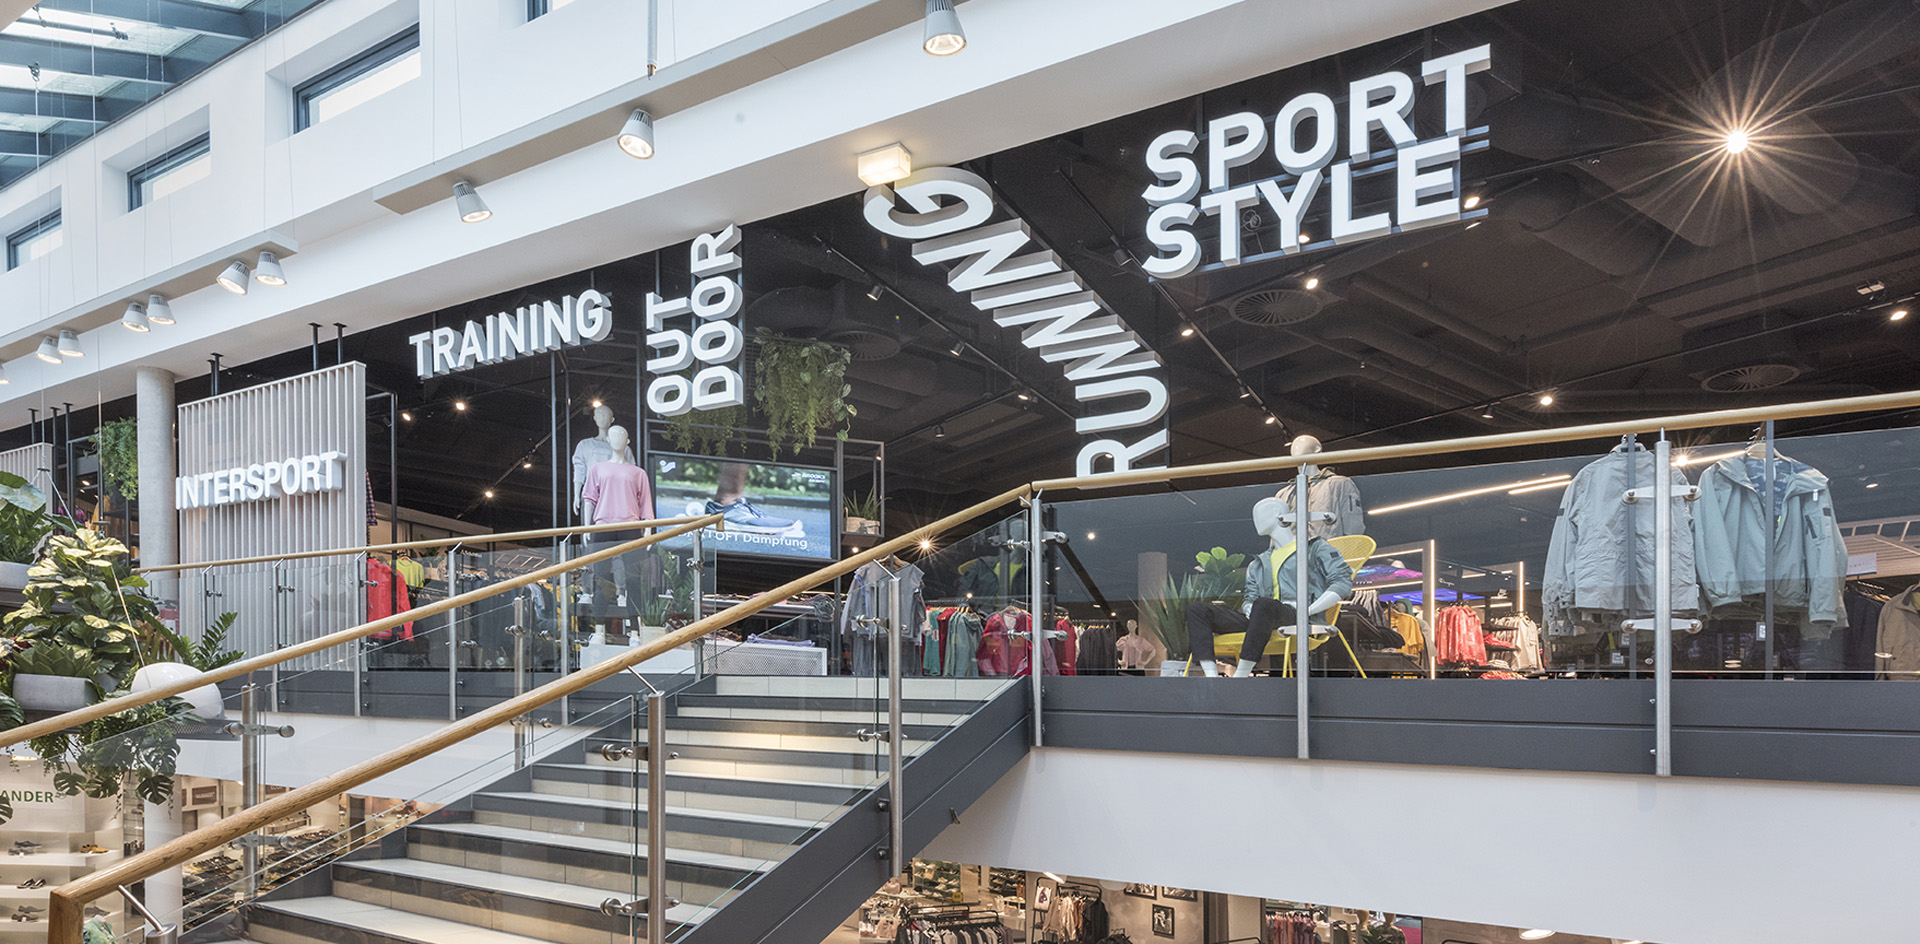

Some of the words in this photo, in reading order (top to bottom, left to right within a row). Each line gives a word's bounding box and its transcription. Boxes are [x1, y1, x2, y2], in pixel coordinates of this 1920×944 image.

[1141, 43, 1491, 206] SPORT
[1141, 135, 1460, 279] STYLE
[409, 289, 612, 379] TRAINING
[646, 291, 693, 416] OUT
[691, 223, 743, 411] DOOR
[863, 166, 1169, 486] RUNNING
[175, 451, 347, 510] INTERSPORT
[743, 532, 808, 549] Dämpfung
